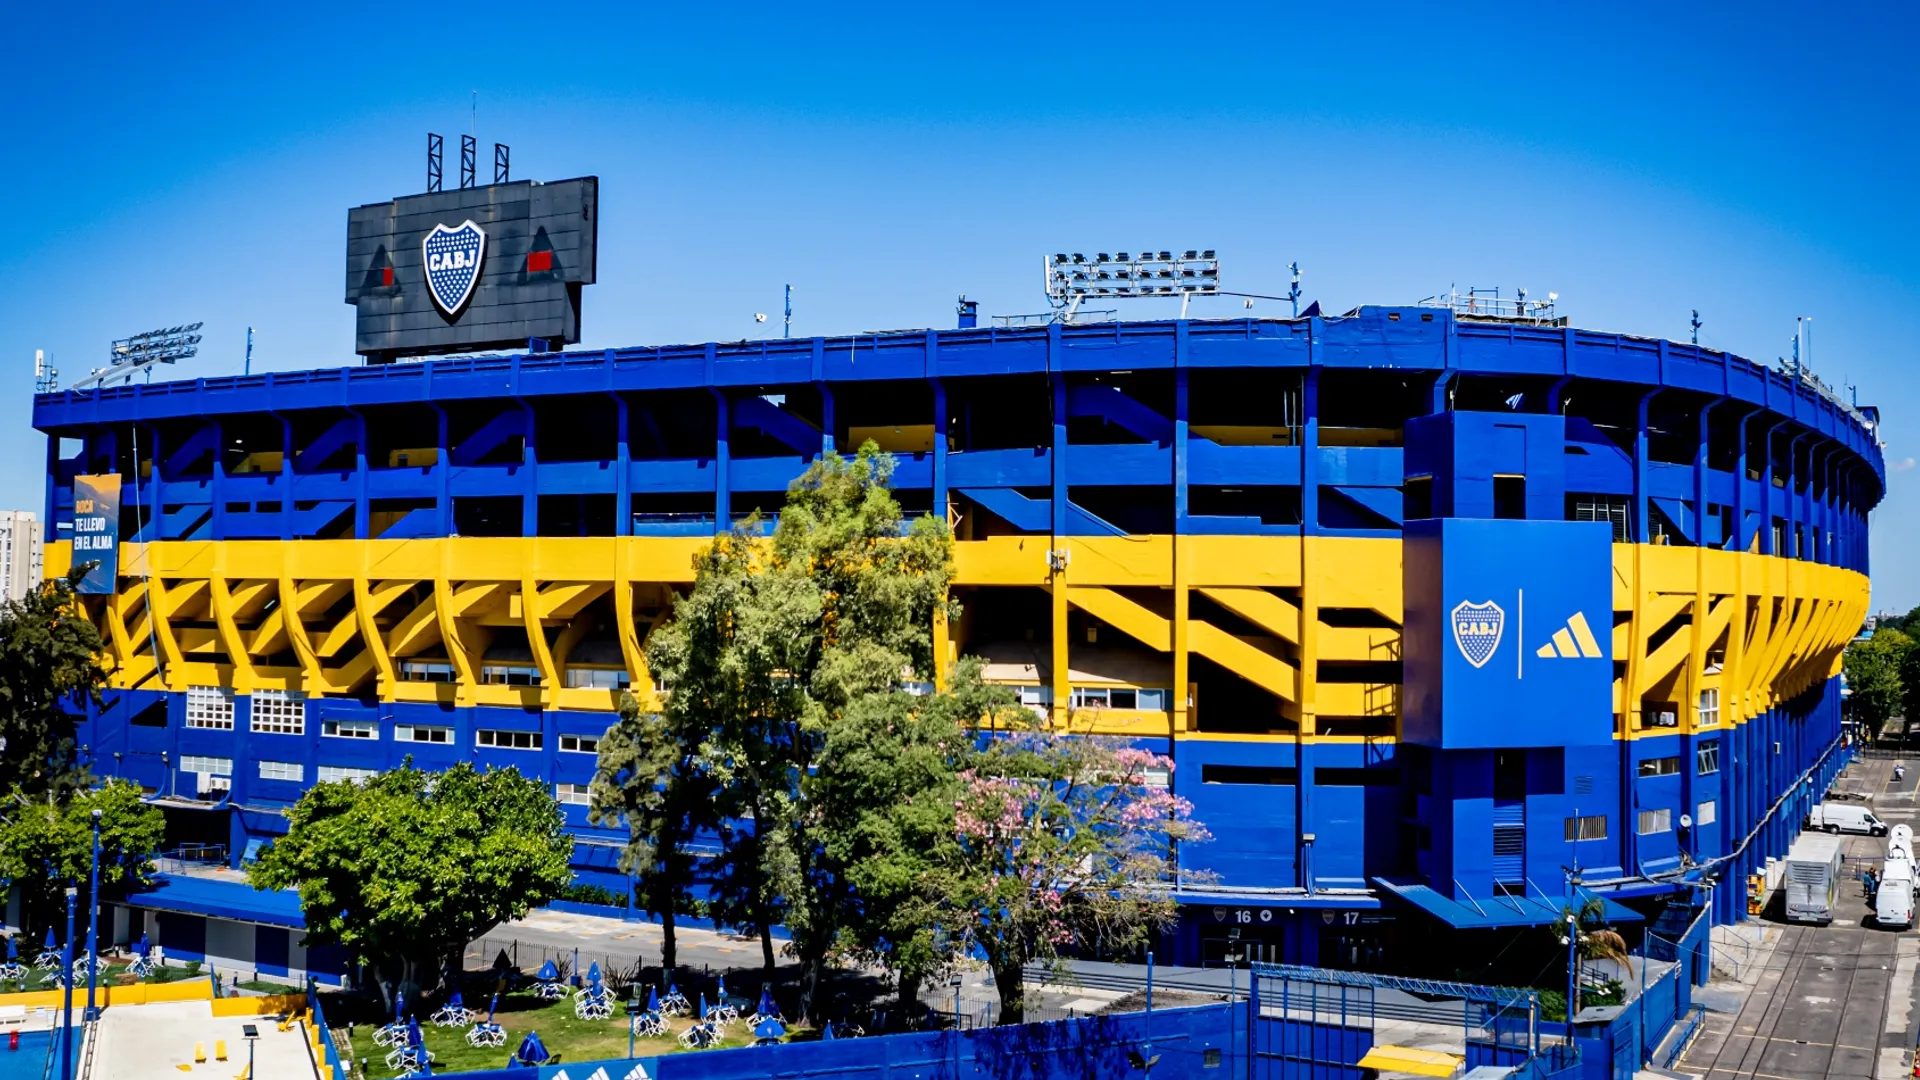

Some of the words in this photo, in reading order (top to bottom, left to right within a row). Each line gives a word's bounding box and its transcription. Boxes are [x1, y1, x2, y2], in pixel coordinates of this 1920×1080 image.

[430, 249, 475, 271] CABJ
[75, 518, 83, 531] TE
[84, 518, 105, 531] LLEVO
[74, 536, 83, 550] EN
[83, 536, 91, 549] EL
[92, 536, 112, 549] ALMA
[1459, 622, 1498, 635] CABJ
[1235, 910, 1252, 924] 16
[1343, 911, 1360, 925] 17
